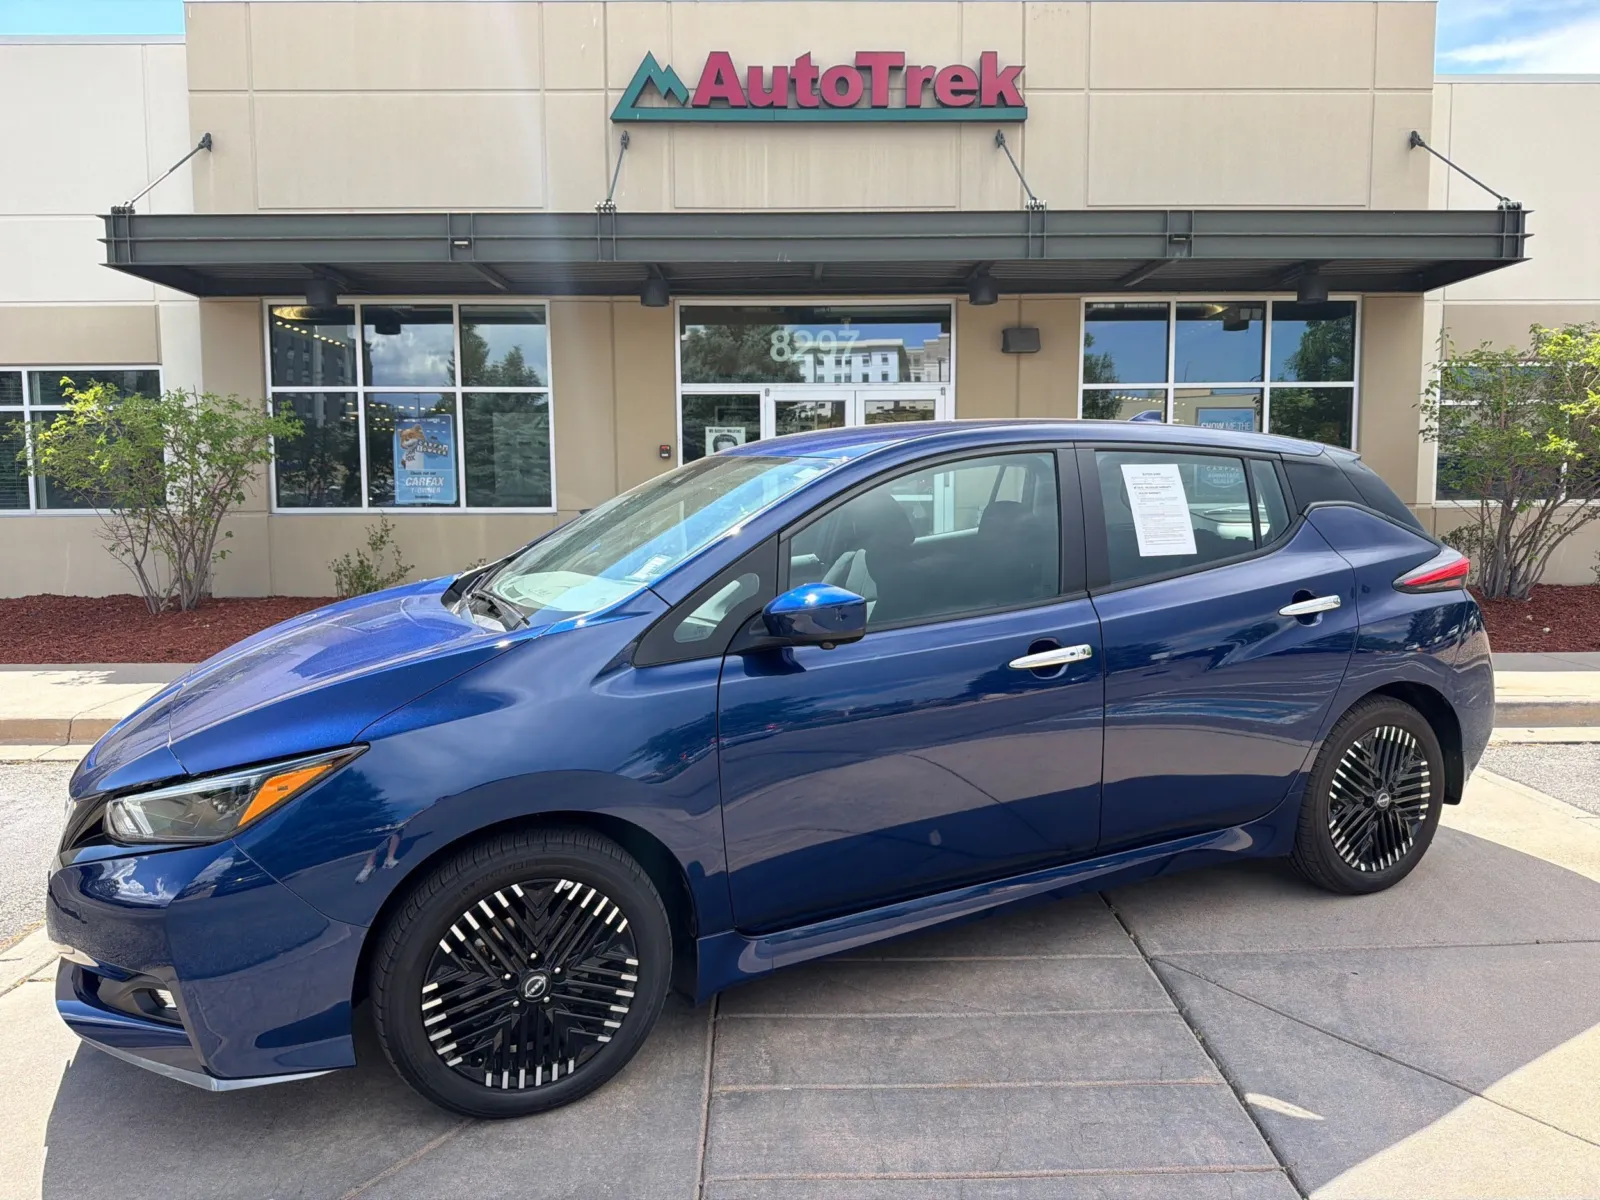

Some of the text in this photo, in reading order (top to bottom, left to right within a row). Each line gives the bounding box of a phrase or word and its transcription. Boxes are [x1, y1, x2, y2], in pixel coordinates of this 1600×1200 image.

[691, 51, 1026, 108] AutoTrek
[769, 329, 860, 363] 8297
[1238, 422, 1251, 431] THE
[405, 477, 444, 486] CARFAX
